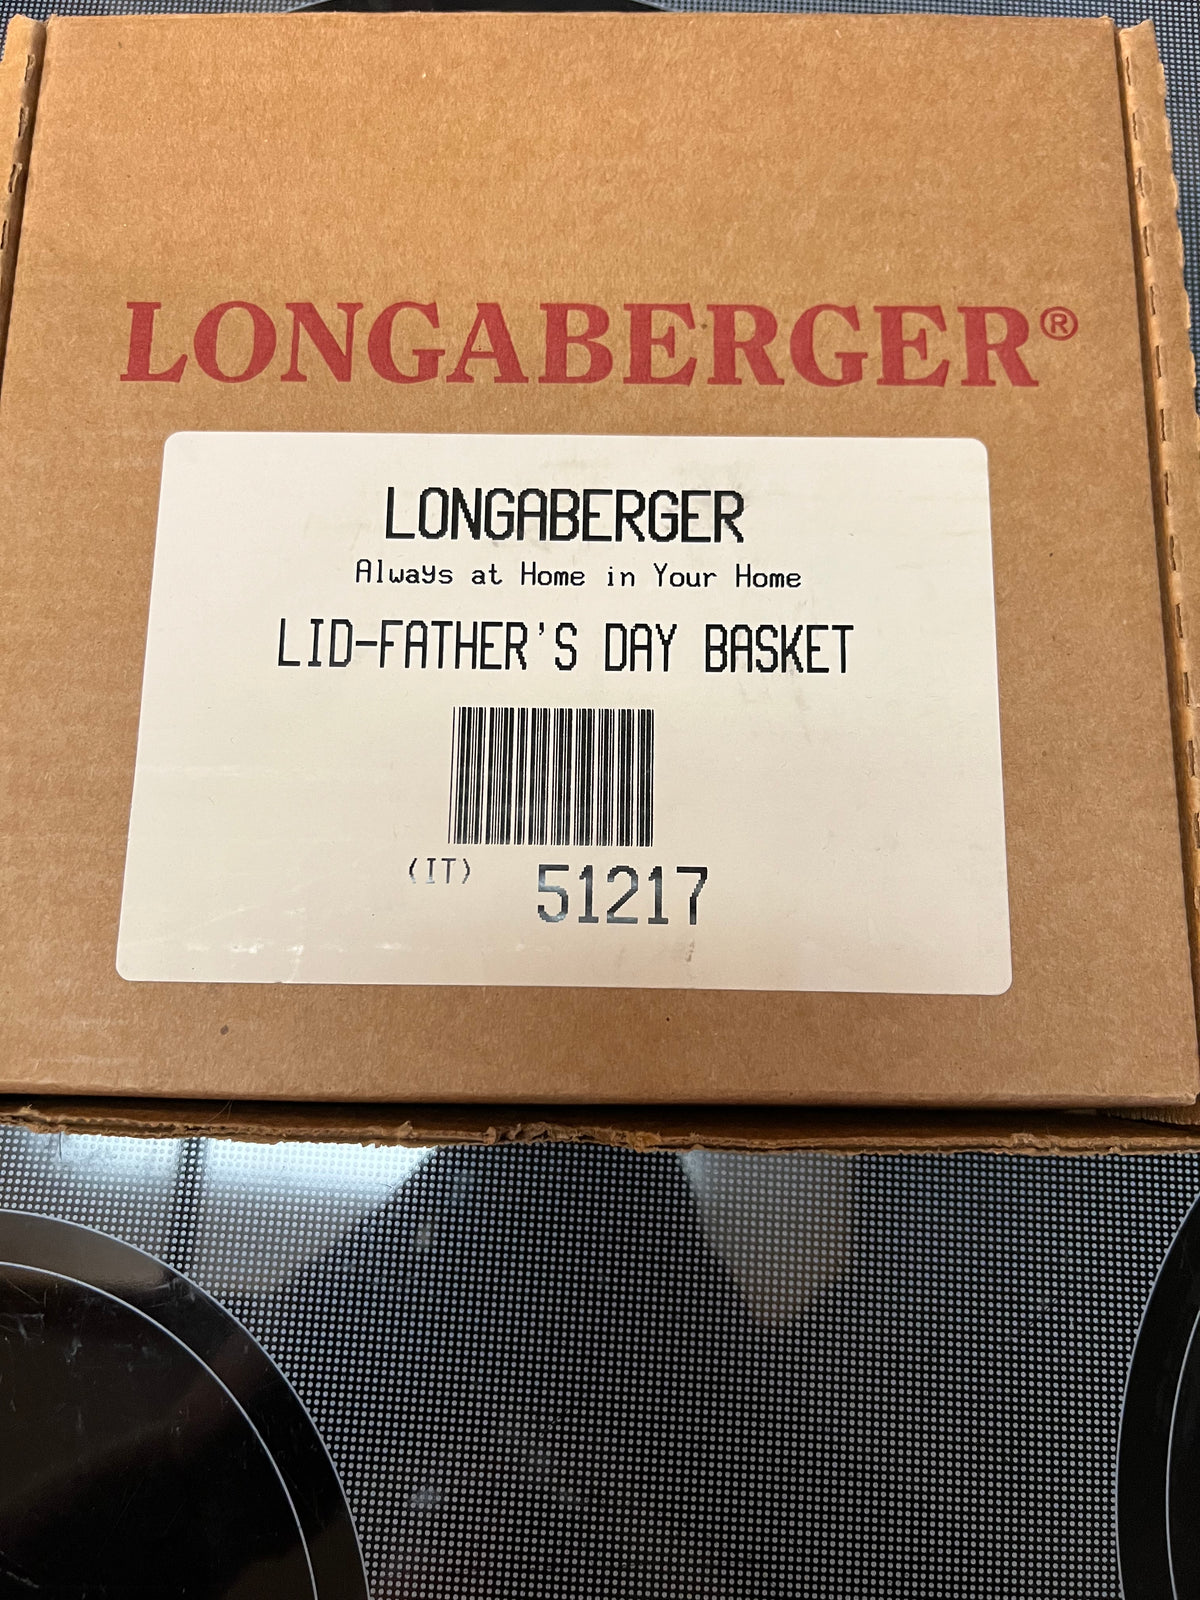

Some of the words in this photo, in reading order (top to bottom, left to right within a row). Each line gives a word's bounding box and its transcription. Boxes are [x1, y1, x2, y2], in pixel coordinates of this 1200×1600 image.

[385, 486, 745, 544] LONGABERGER
[355, 558, 453, 586] Always
[471, 563, 503, 585] at
[521, 560, 586, 587] Home
[607, 562, 635, 588] in
[653, 562, 718, 588] Your
[735, 563, 802, 588] Home
[277, 617, 578, 671] LID-FATHER'S
[604, 622, 678, 673] DAY
[705, 624, 854, 674] BASKET
[407, 857, 472, 885] (IT)
[537, 864, 708, 926] 51217
